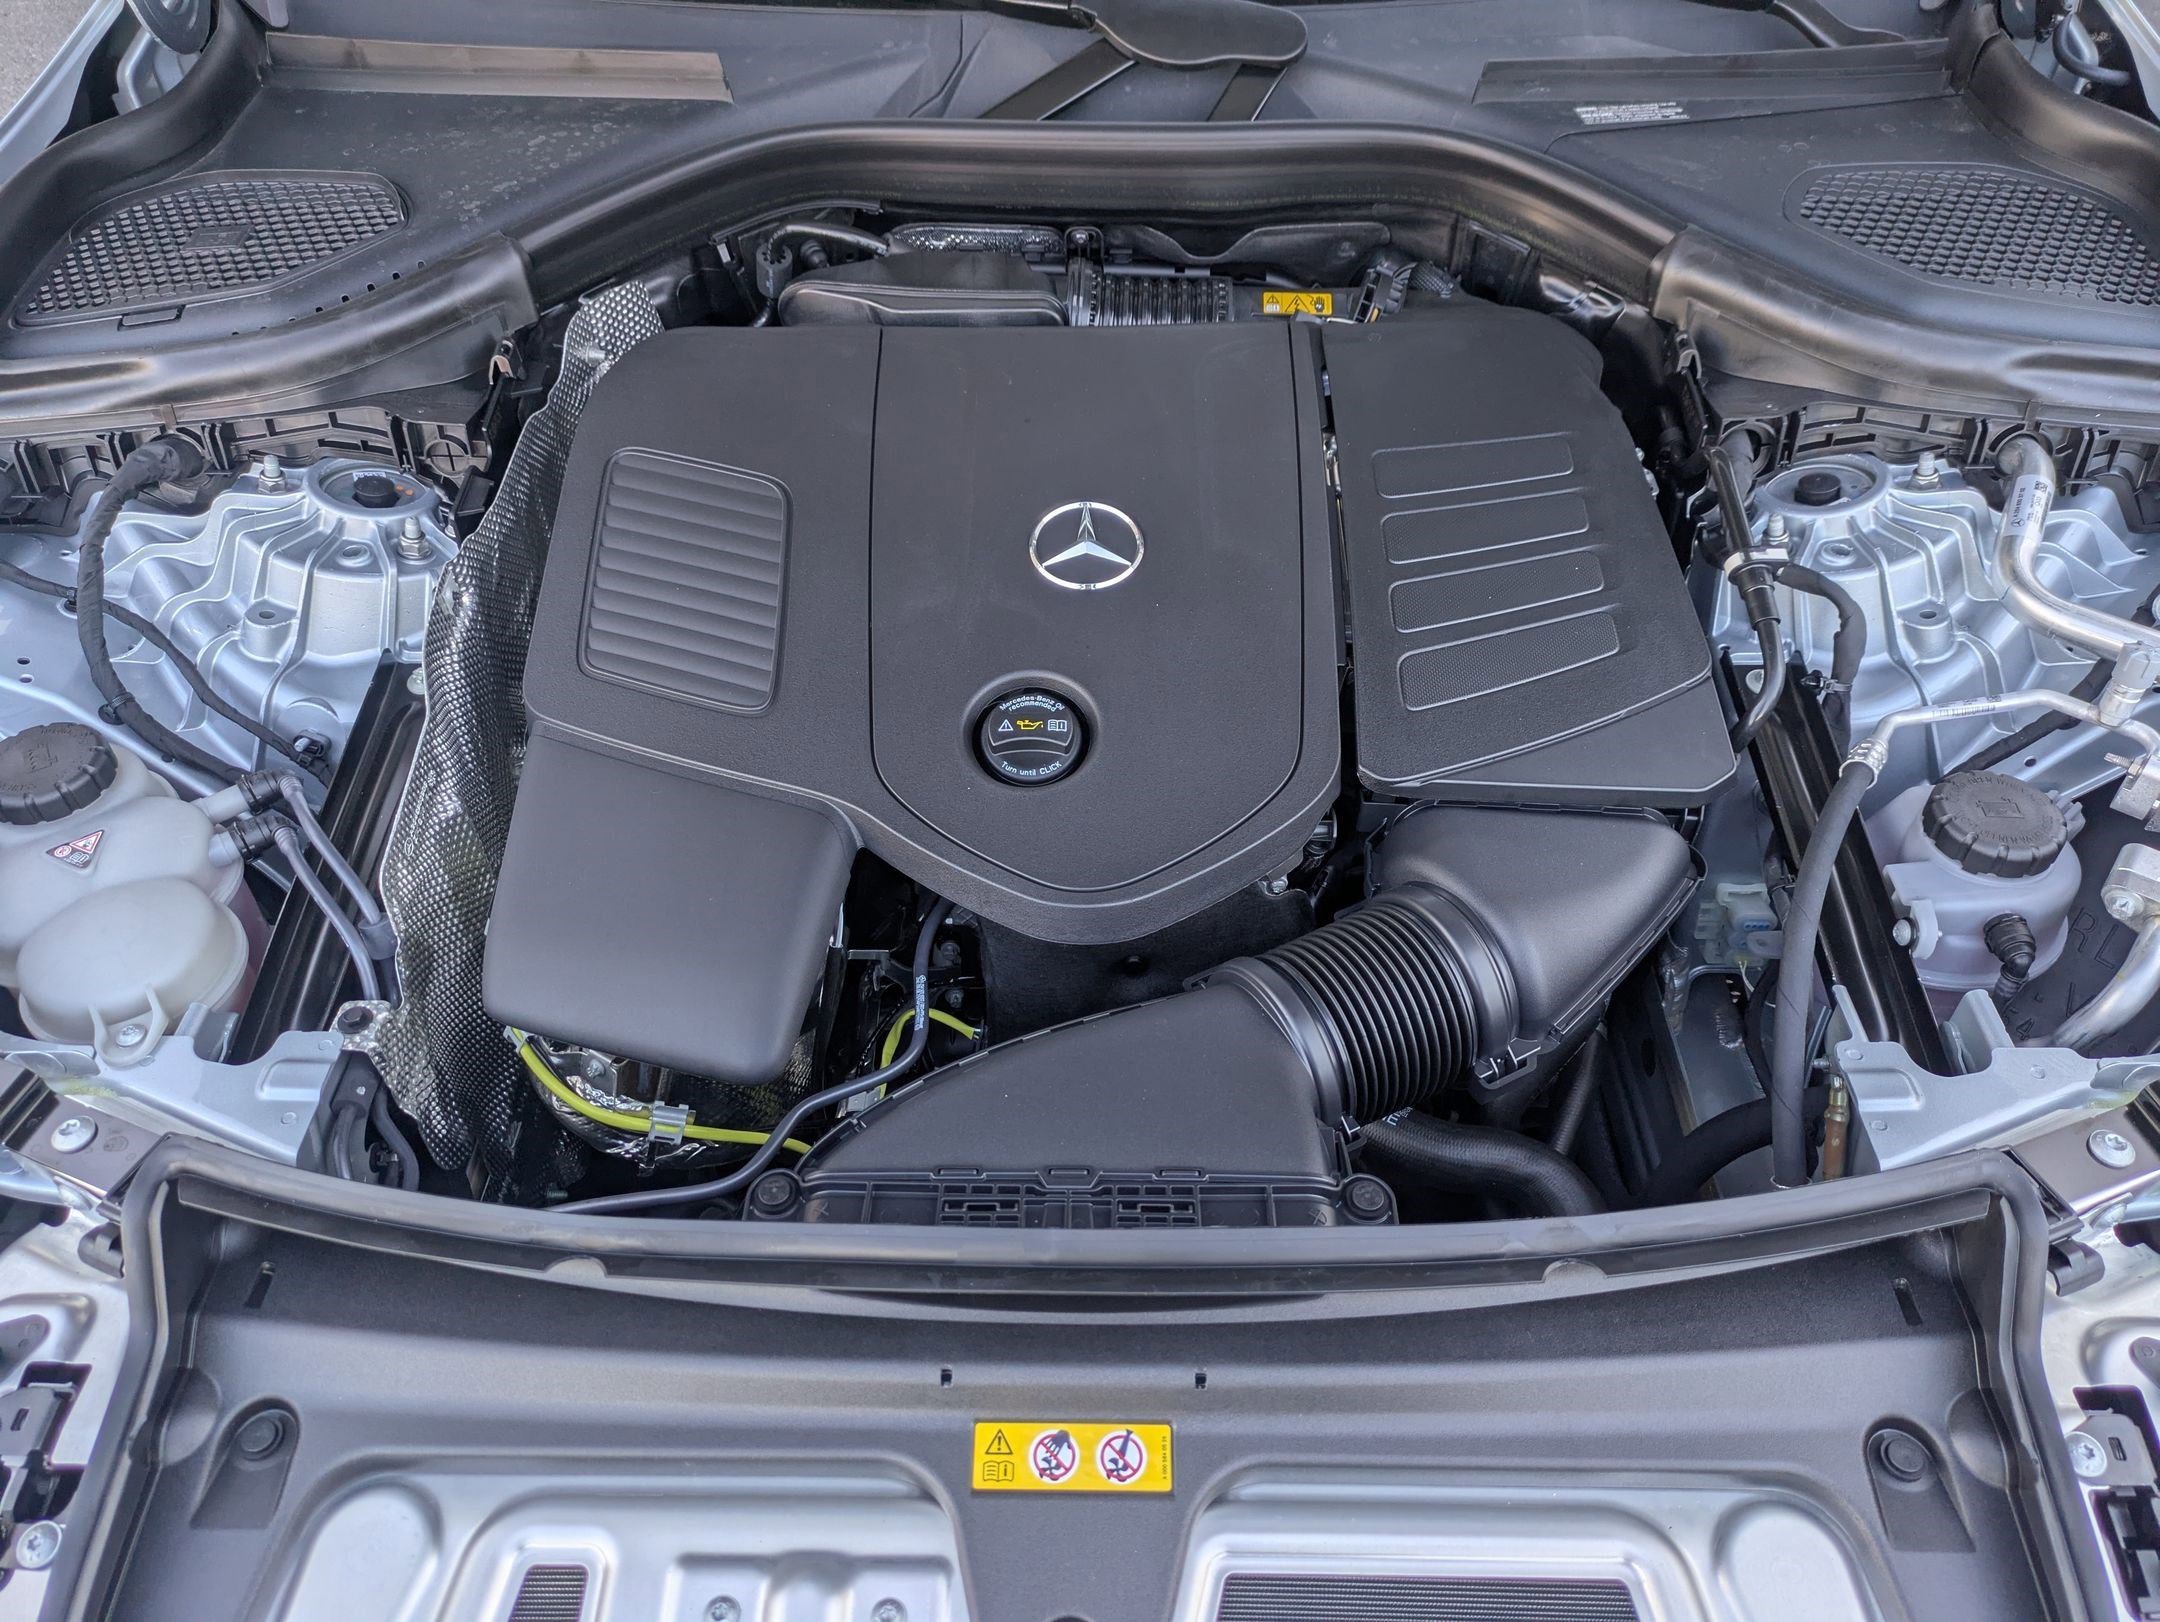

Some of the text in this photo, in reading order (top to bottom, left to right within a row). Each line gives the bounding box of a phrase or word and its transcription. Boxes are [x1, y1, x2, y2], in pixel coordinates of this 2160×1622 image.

[1000, 695, 1055, 710] Mercedes-Benz
[1008, 701, 1057, 712] recommended
[1001, 761, 1017, 773] Turn
[1039, 761, 1063, 775] CLICK
